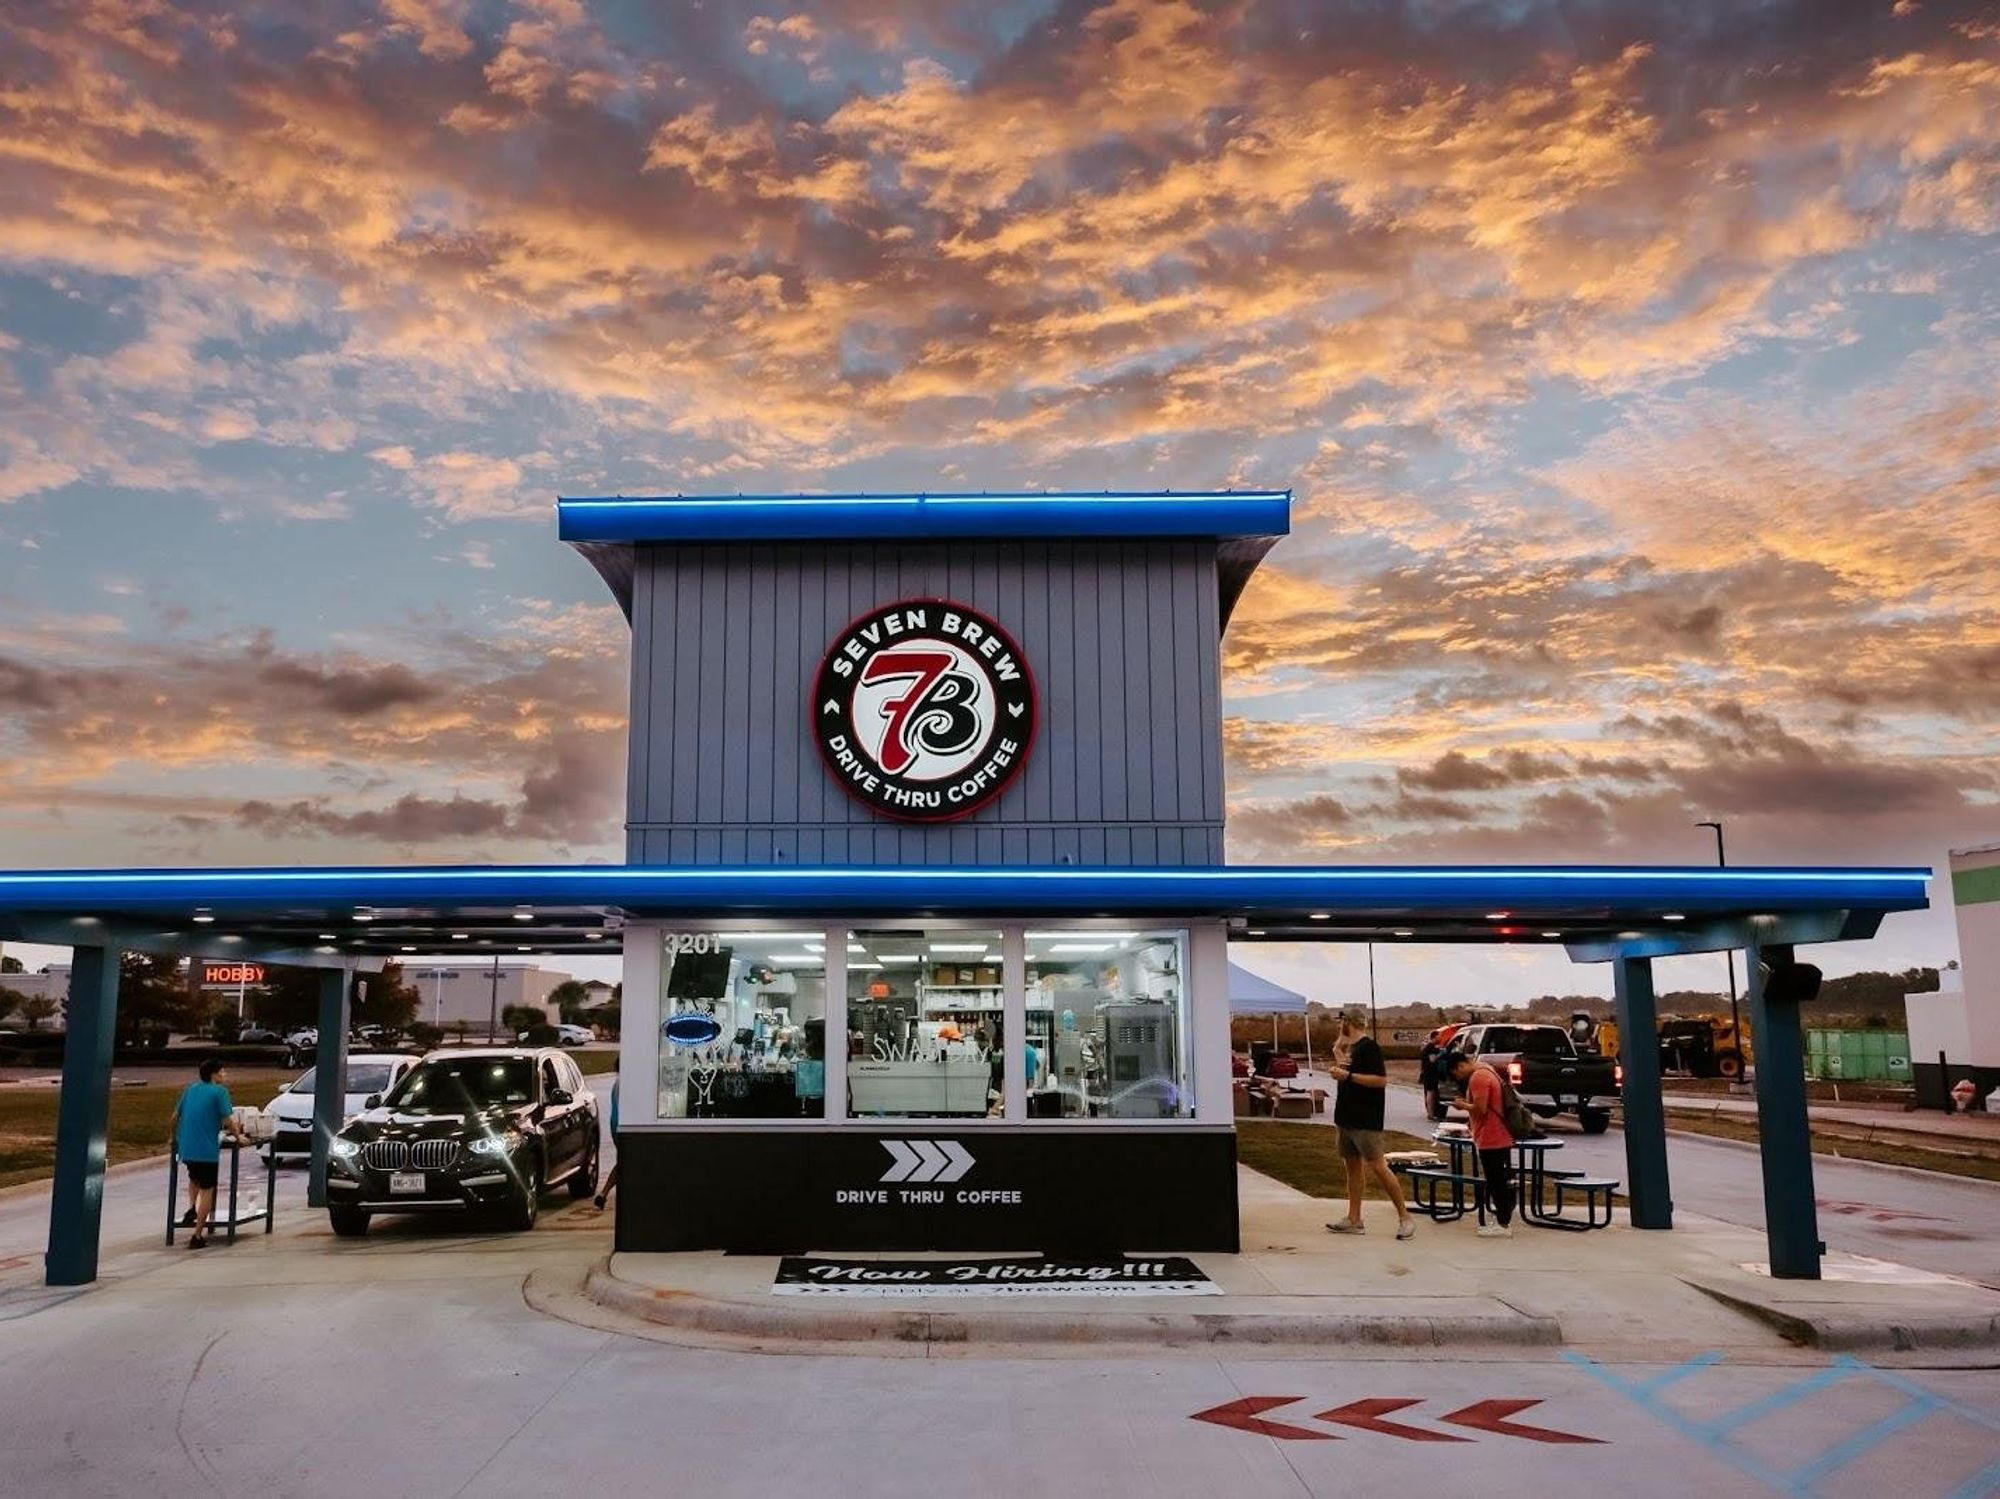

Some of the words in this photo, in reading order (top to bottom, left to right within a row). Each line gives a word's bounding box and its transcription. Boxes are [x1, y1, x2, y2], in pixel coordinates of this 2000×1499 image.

[833, 609, 927, 678] SEVEN
[941, 612, 1021, 682] BREW
[828, 733, 880, 794] DRIVE
[882, 783, 941, 808] THRU
[947, 737, 1019, 804] COFFEE
[664, 932, 720, 955] 3201
[206, 966, 265, 982] HOBBY
[836, 1190, 889, 1204] DRIVE
[899, 1190, 945, 1204] THRU
[956, 1190, 1022, 1204] COFFEE
[807, 1264, 931, 1281] Now
[945, 1262, 1166, 1281] Hiring!!!
